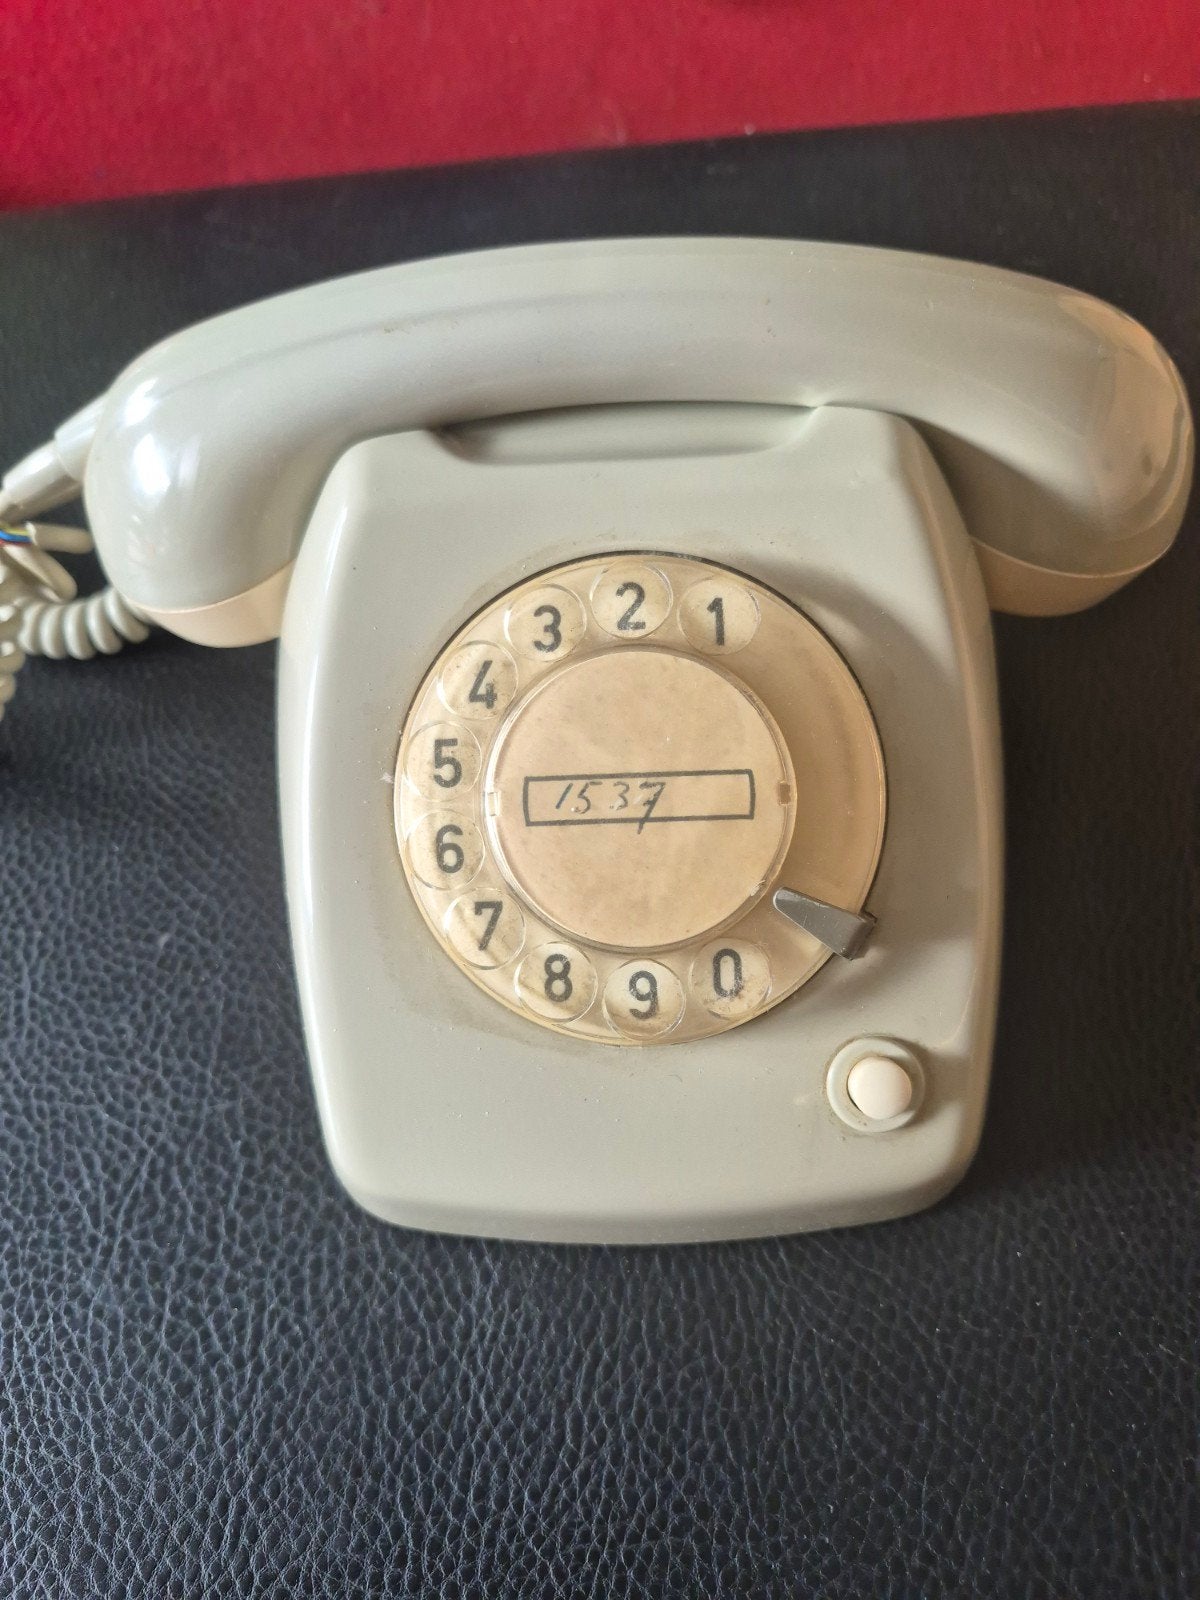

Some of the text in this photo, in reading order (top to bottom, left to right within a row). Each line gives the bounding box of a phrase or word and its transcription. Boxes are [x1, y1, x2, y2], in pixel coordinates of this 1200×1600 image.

[533, 605, 563, 652] 3
[616, 581, 646, 631] 2
[706, 597, 725, 646] 1
[468, 660, 498, 709] 4
[433, 738, 463, 788] 5
[555, 780, 666, 834] 1537
[435, 824, 465, 874] 6
[472, 901, 503, 951] 7
[543, 953, 573, 1003] 8
[629, 971, 659, 1020] 9
[712, 948, 743, 999] 0
